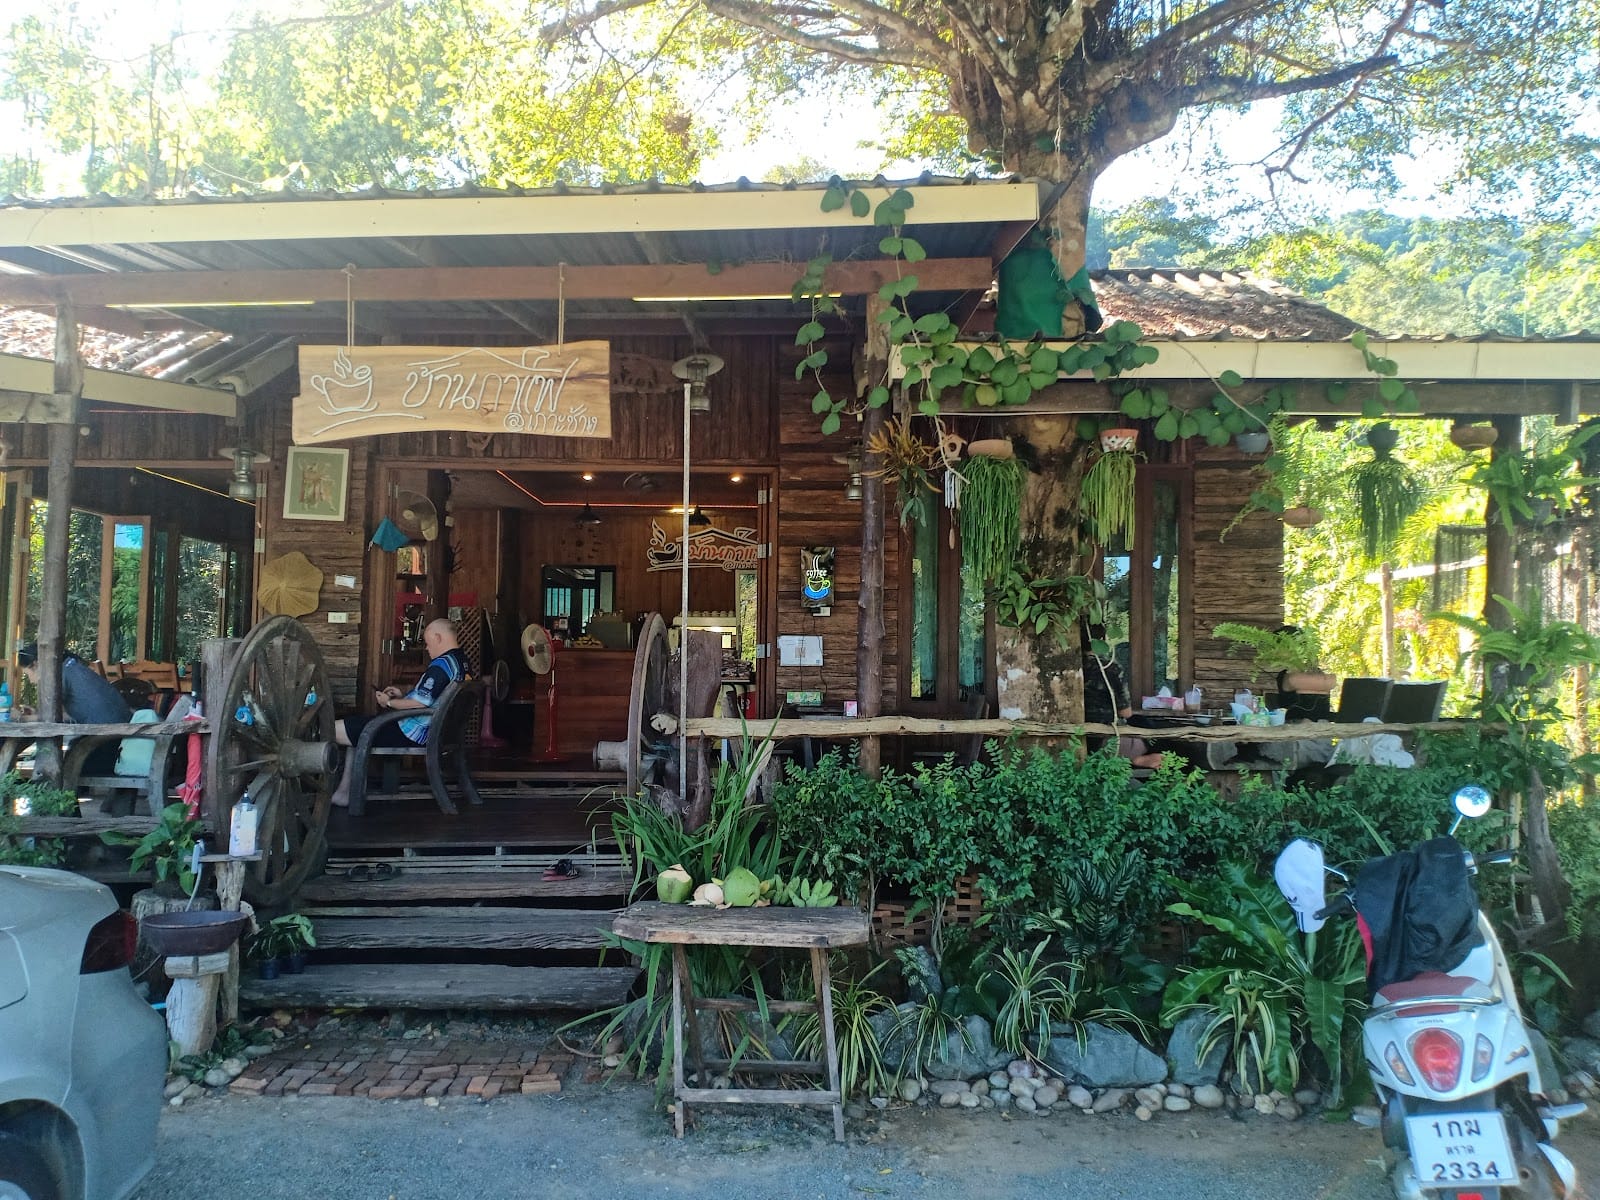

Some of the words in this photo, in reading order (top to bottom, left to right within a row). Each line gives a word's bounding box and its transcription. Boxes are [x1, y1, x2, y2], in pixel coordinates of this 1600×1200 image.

[402, 358, 578, 413] บ้านกาแฟ
[1432, 1161, 1500, 1182] 2334
